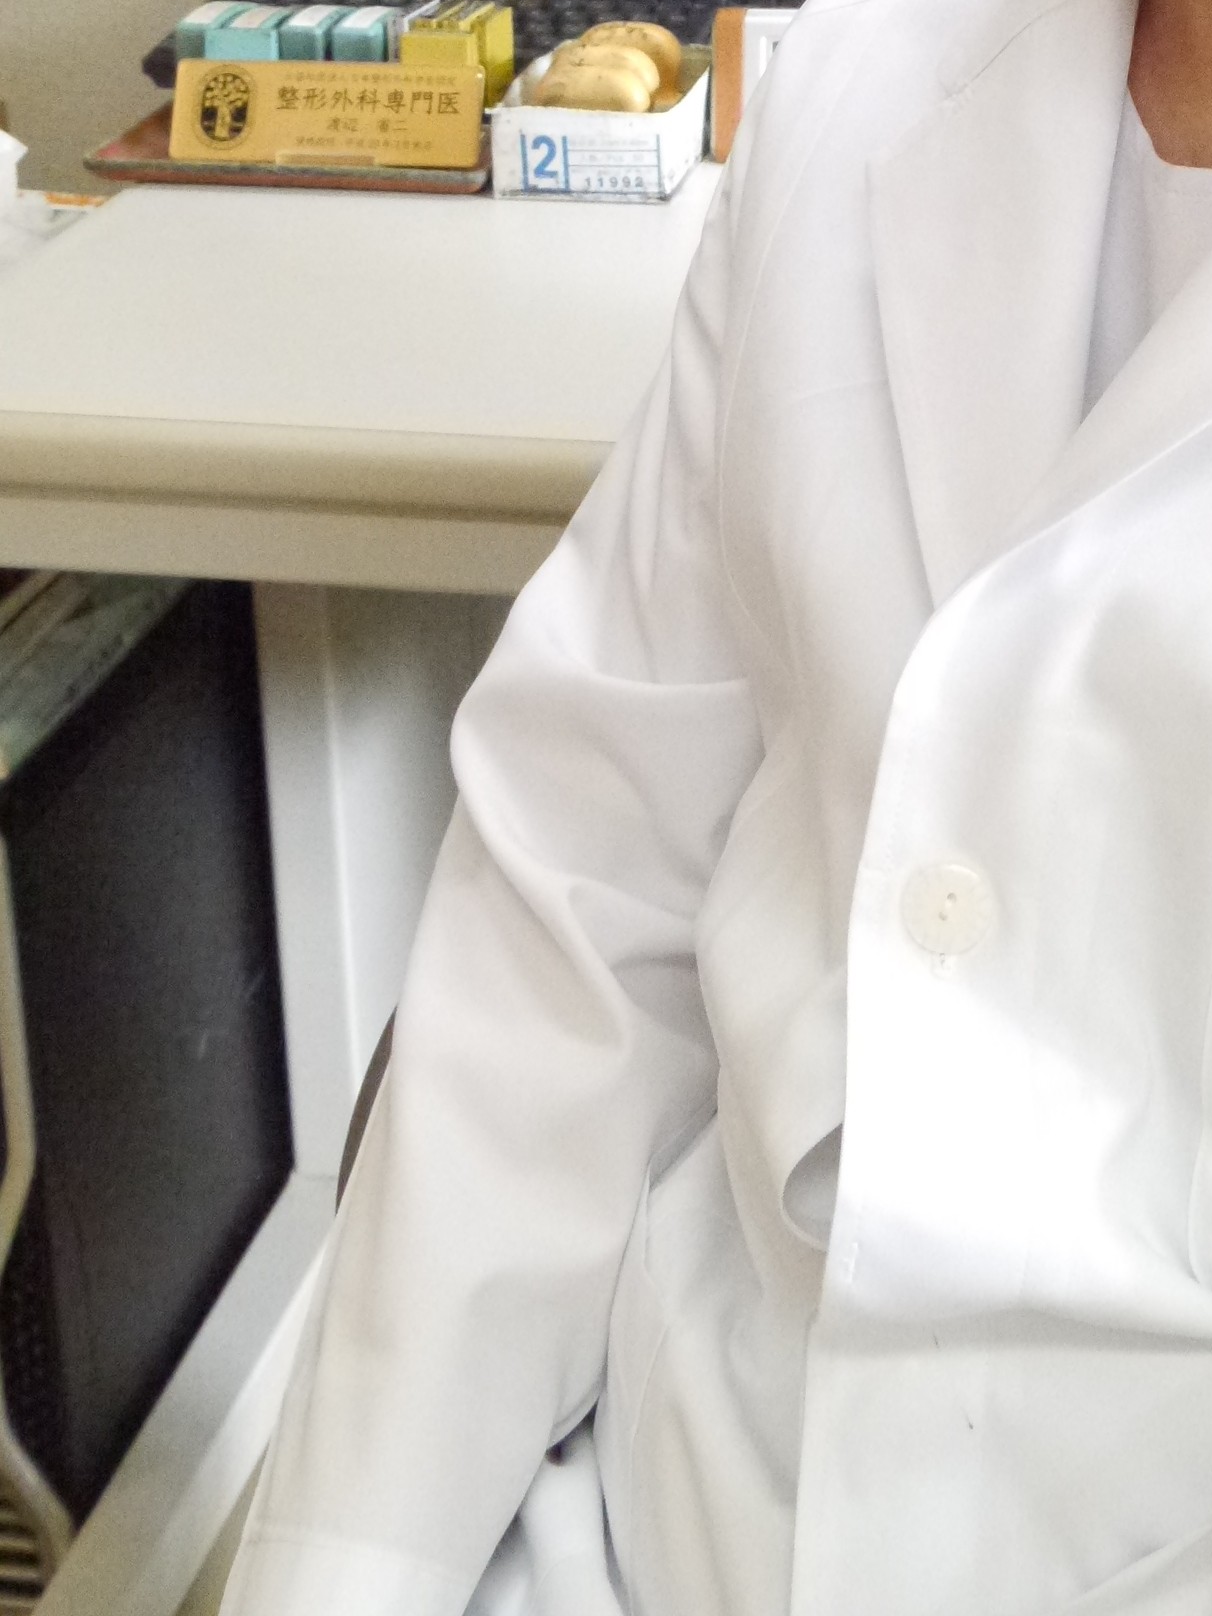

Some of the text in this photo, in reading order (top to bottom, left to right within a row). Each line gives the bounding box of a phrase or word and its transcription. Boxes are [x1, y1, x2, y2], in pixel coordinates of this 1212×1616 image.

[276, 85, 461, 115] 整形外科専門医
[531, 135, 558, 178] 2
[585, 176, 643, 188] 11992
